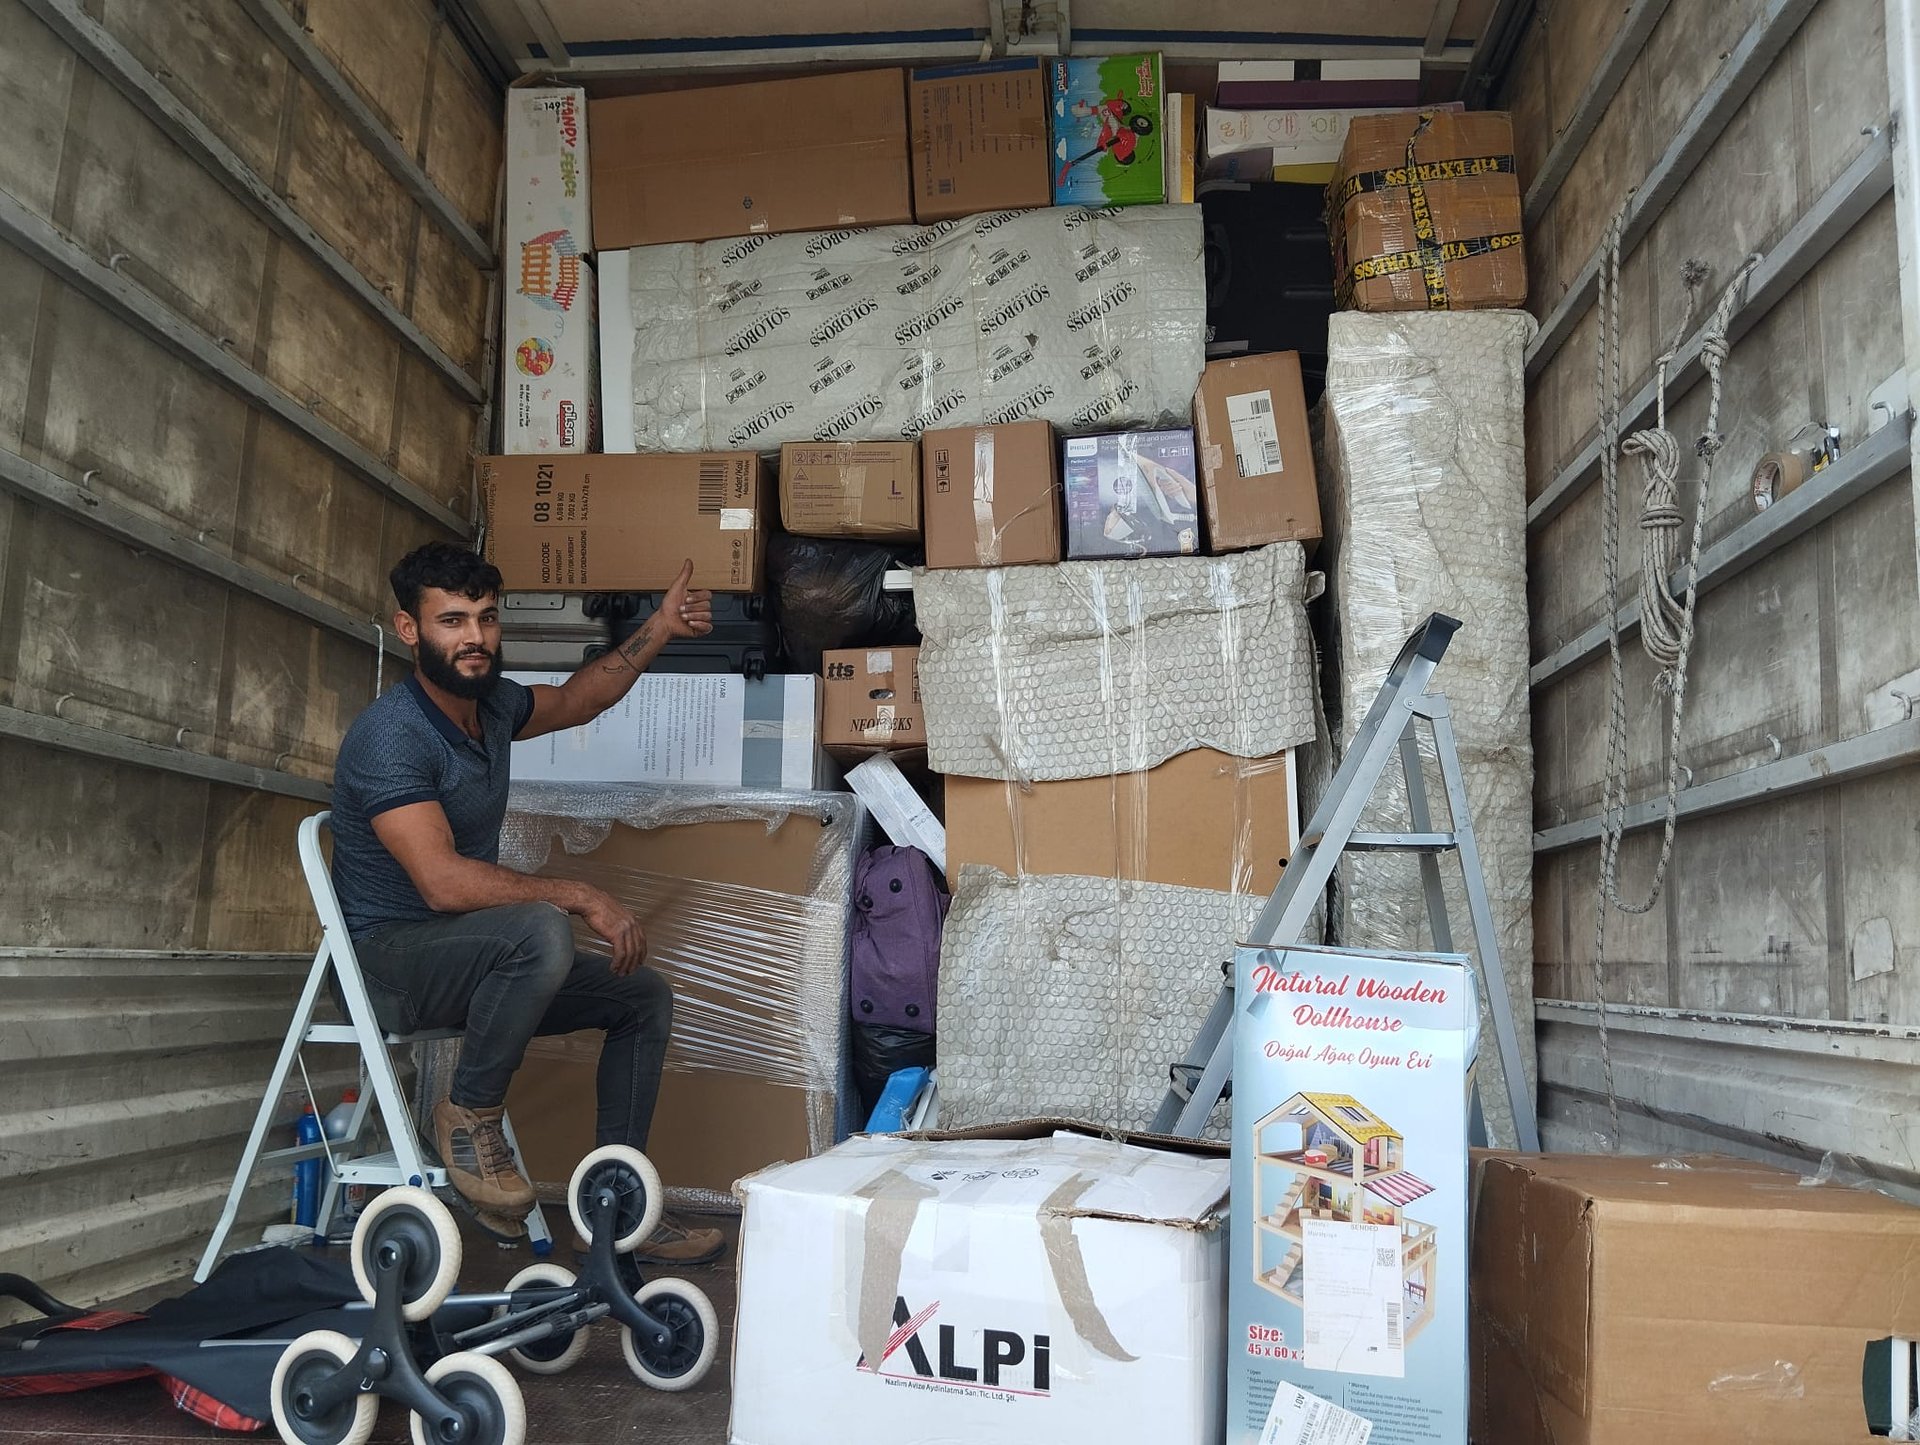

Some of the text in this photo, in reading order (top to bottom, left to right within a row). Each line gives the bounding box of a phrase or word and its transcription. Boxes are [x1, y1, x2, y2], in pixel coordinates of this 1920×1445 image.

[809, 298, 879, 348] SOLOBOSS
[894, 297, 965, 346] SOLOBOSS
[980, 284, 1051, 337] SOLOBOSS
[1066, 282, 1138, 333] SOLOBOSS
[724, 306, 791, 358] SOLOBOSS
[562, 404, 577, 446] pilsan
[727, 401, 795, 449] SOLOBOSS
[533, 463, 554, 524] 08 1021
[891, 480, 902, 496] L
[541, 541, 551, 584] KOD/CODE
[826, 662, 856, 678] tts
[1252, 965, 1449, 1004] Natural Wooden
[1293, 1004, 1404, 1032] Dollhouse
[1264, 1040, 1433, 1070] Doğal Ağaç Oyun Evi
[1248, 1343, 1298, 1359] 45 x 60 x
[1249, 1325, 1283, 1342] Size:
[908, 1380, 926, 1390] Avize
[992, 1391, 1005, 1401] Ltd.
